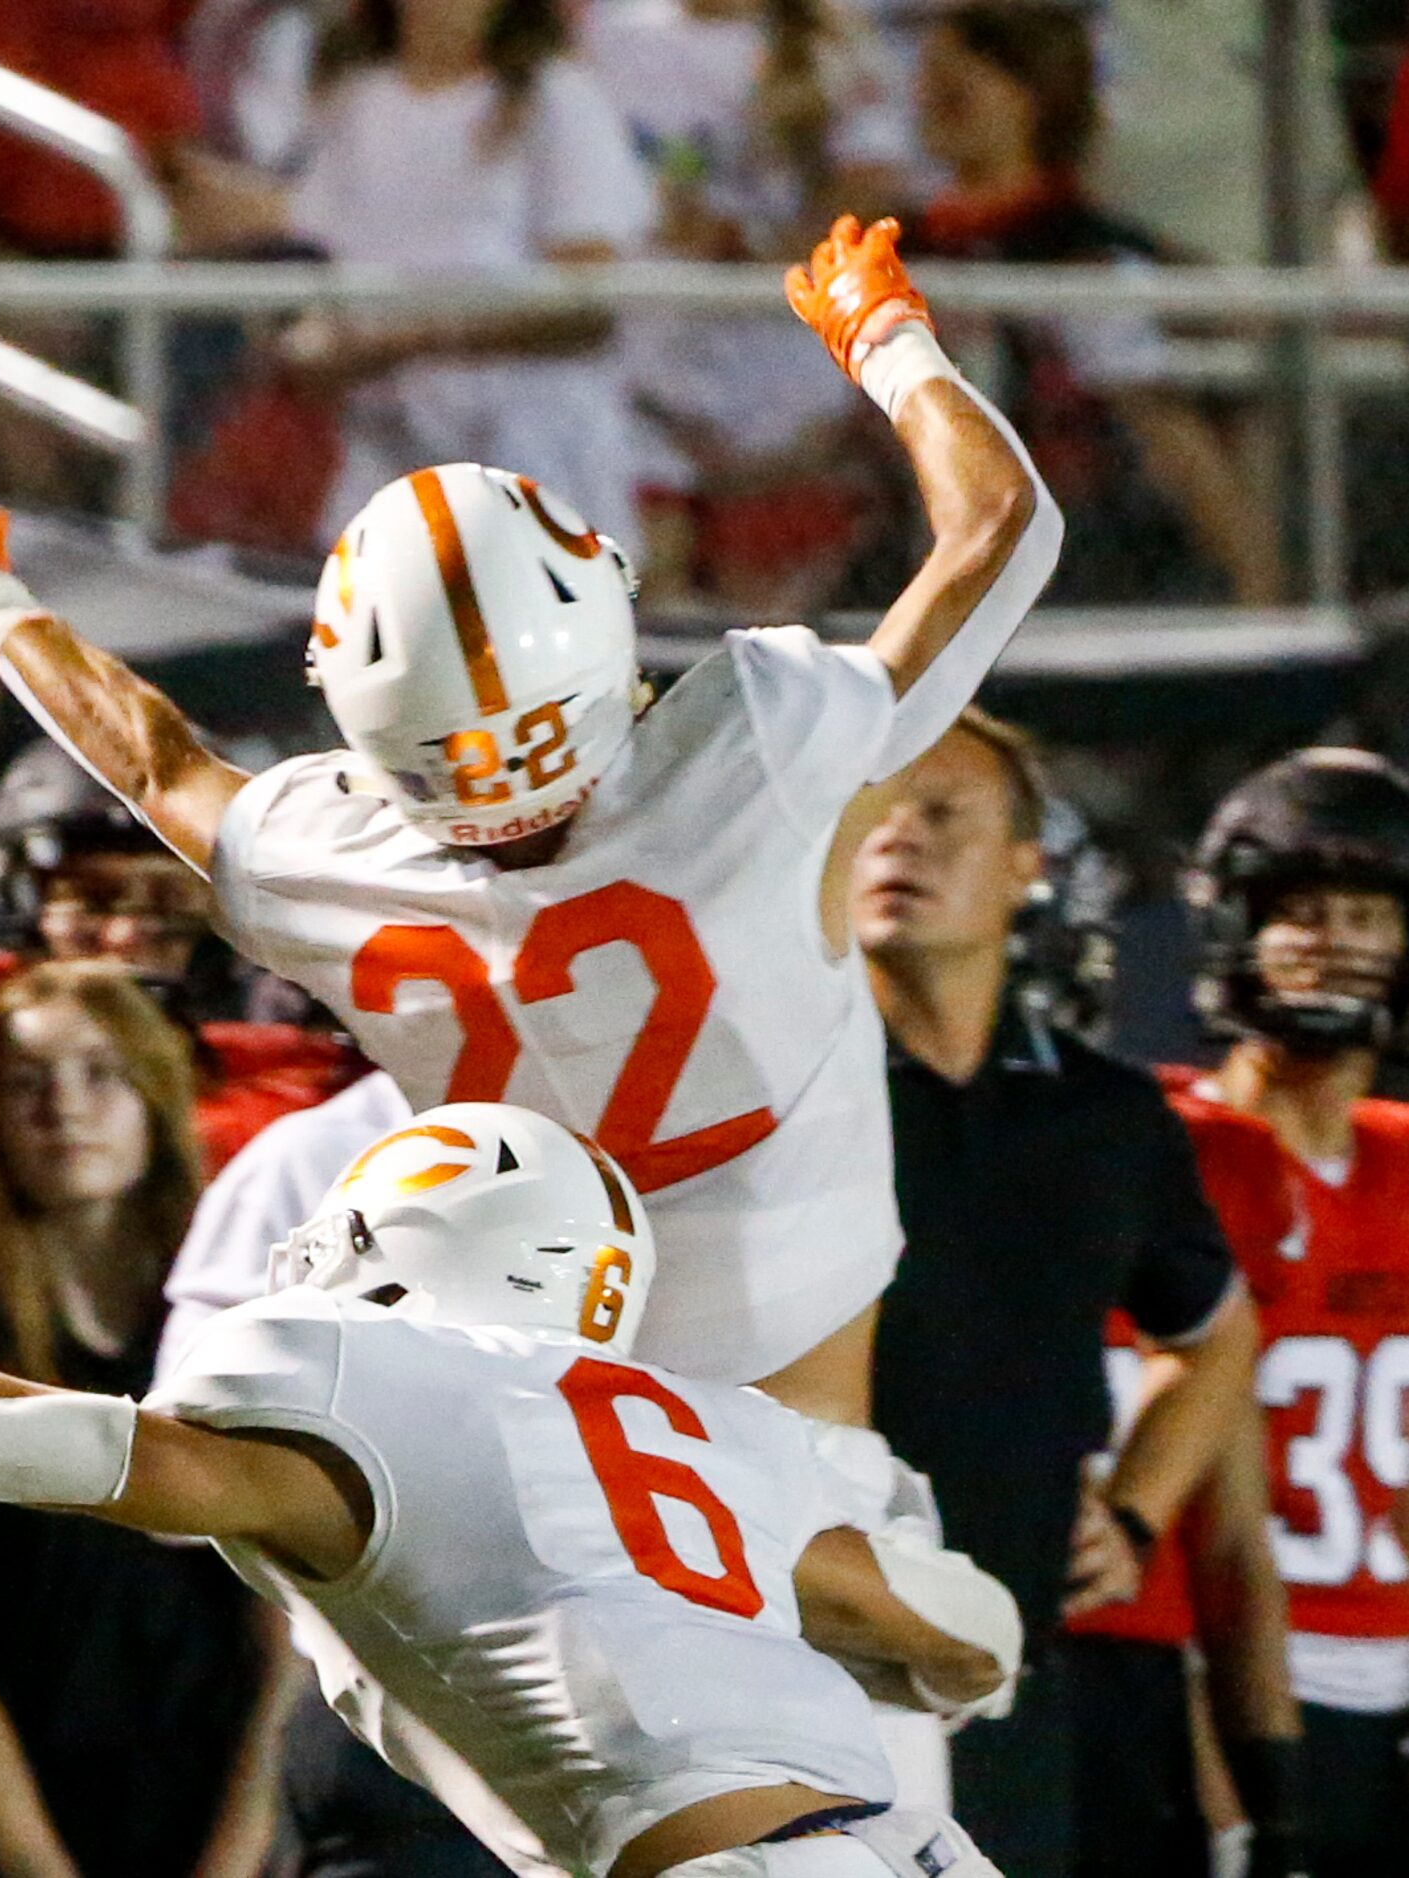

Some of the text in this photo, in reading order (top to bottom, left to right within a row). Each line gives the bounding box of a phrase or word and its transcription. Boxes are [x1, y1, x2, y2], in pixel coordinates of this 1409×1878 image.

[443, 701, 577, 807] 22
[350, 878, 779, 1194] 22
[577, 1244, 633, 1344] 6
[555, 1356, 766, 1620] 6
